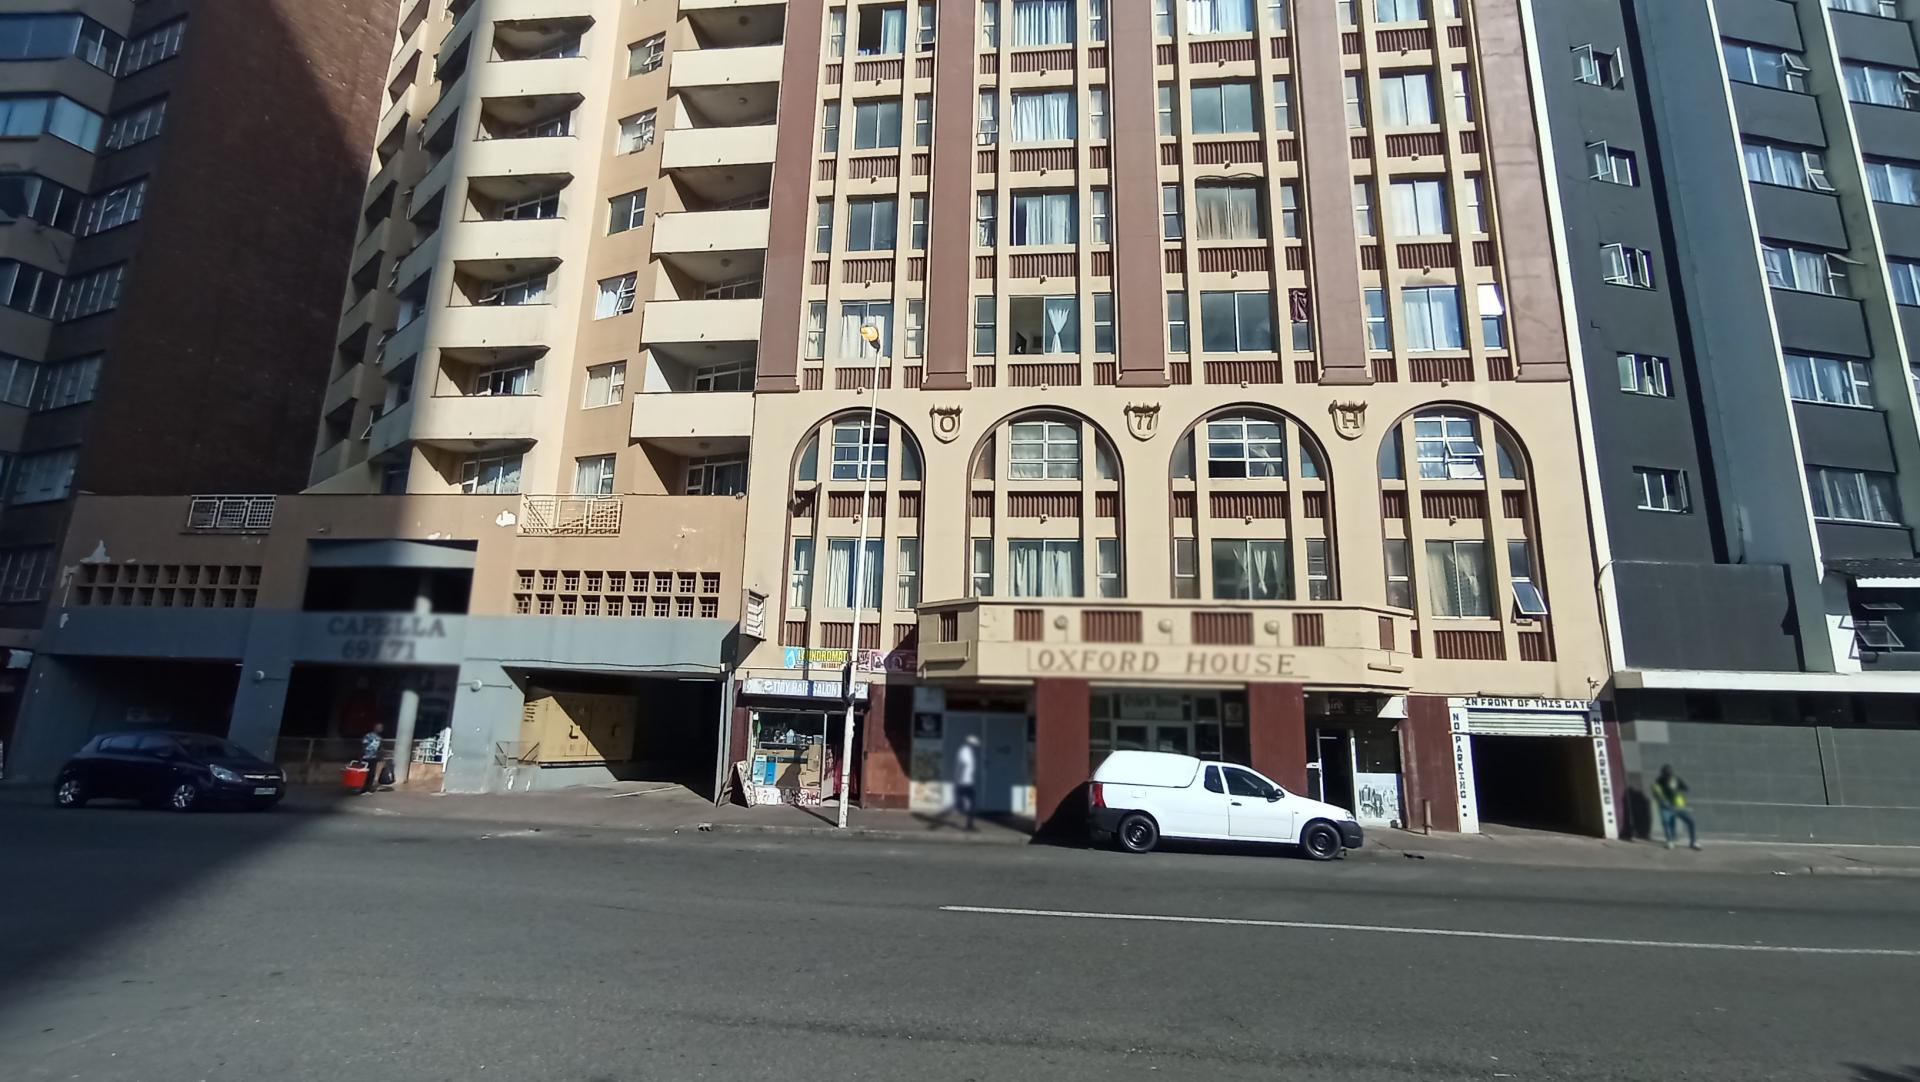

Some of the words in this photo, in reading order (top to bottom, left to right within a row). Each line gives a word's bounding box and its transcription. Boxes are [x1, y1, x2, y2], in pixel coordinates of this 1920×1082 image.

[940, 415, 956, 433] O
[1134, 411, 1155, 430] 77
[1341, 410, 1360, 429] H
[327, 615, 446, 638] CAPELLA
[1037, 648, 1160, 673] OXFORD
[1185, 652, 1296, 676] HOUSE
[1465, 697, 1478, 706] IN
[1481, 699, 1514, 707] FRONT
[1535, 700, 1562, 708] THIS
[1565, 701, 1592, 709] GATE
[1453, 713, 1460, 730] NO
[1455, 736, 1467, 798] PARKING
